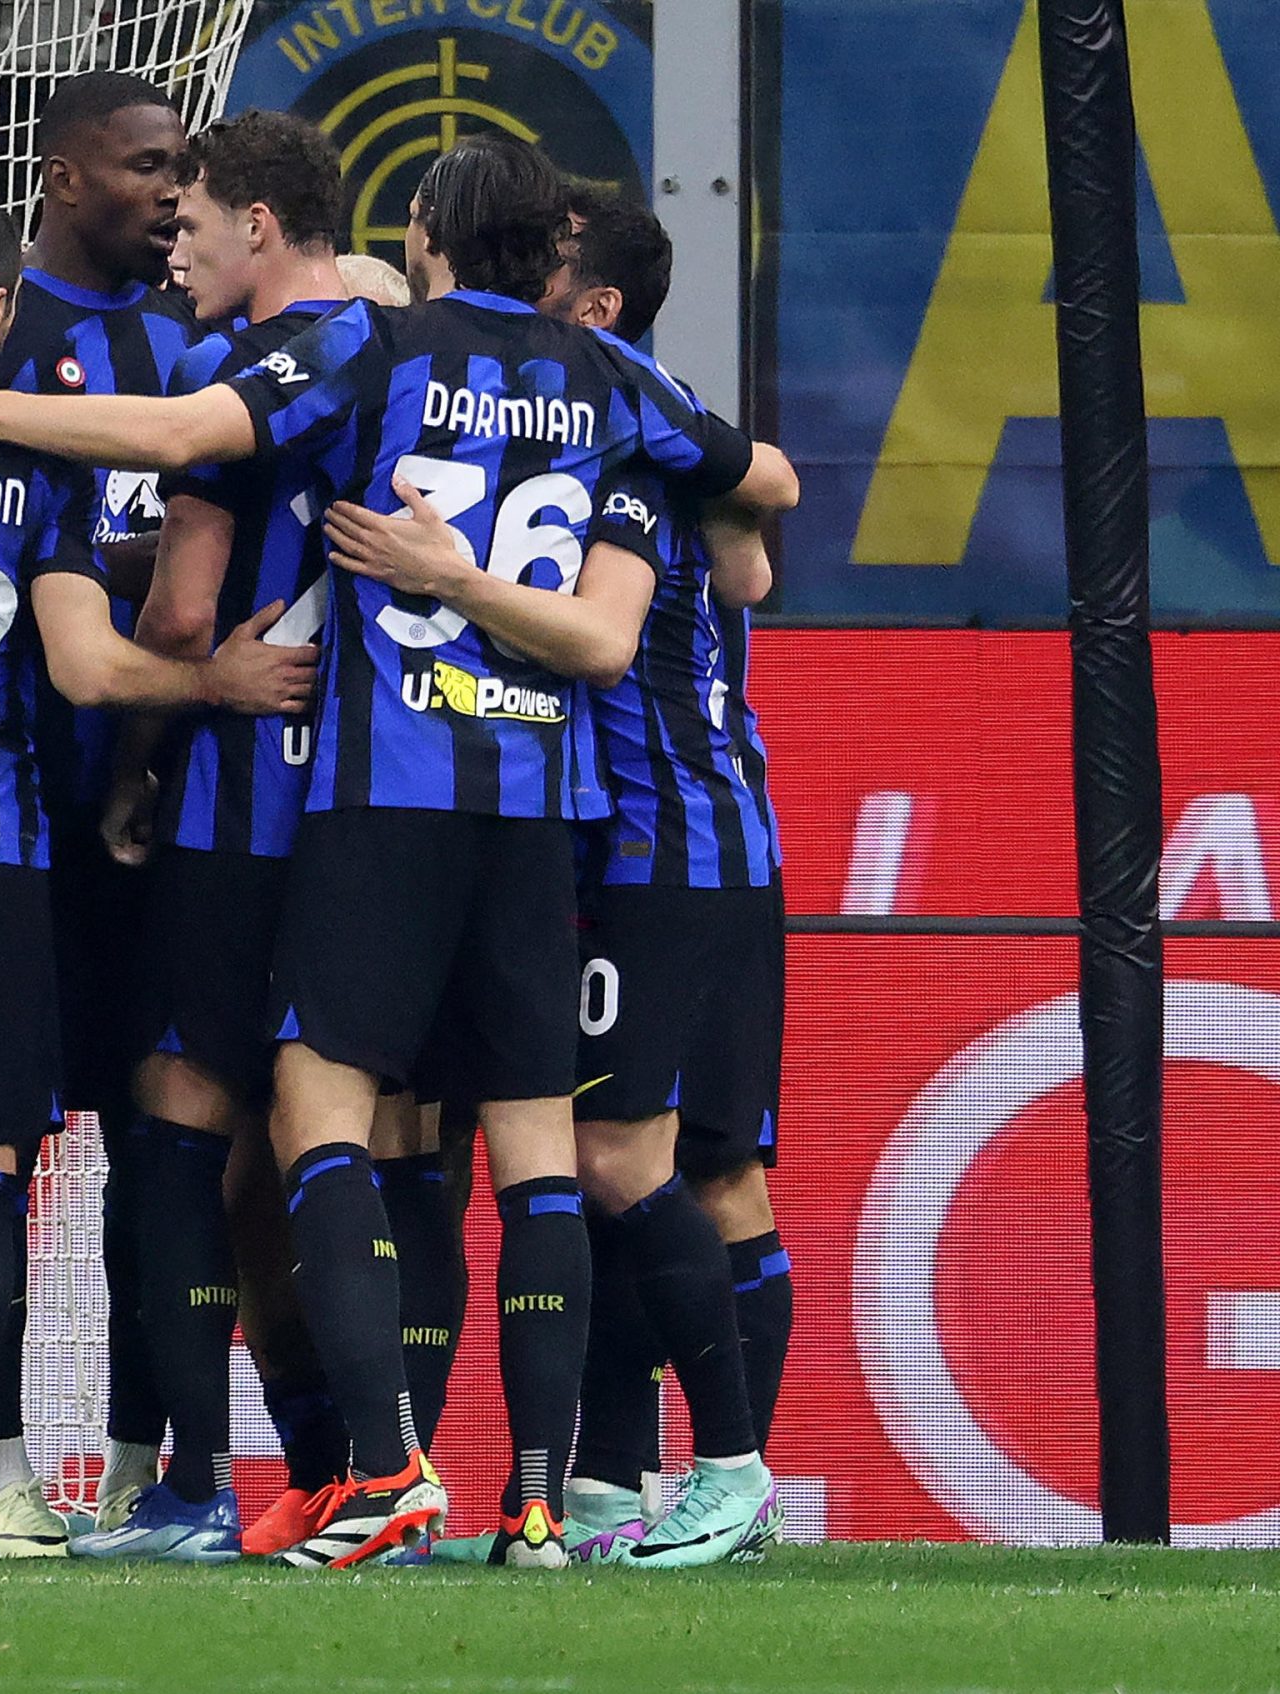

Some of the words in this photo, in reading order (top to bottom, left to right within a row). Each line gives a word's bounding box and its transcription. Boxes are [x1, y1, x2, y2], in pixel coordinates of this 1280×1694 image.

[422, 380, 595, 448] DARMIAN
[190, 1286, 237, 1306] INTER
[505, 1294, 564, 1315] INTER
[403, 1326, 449, 1346] INTER
